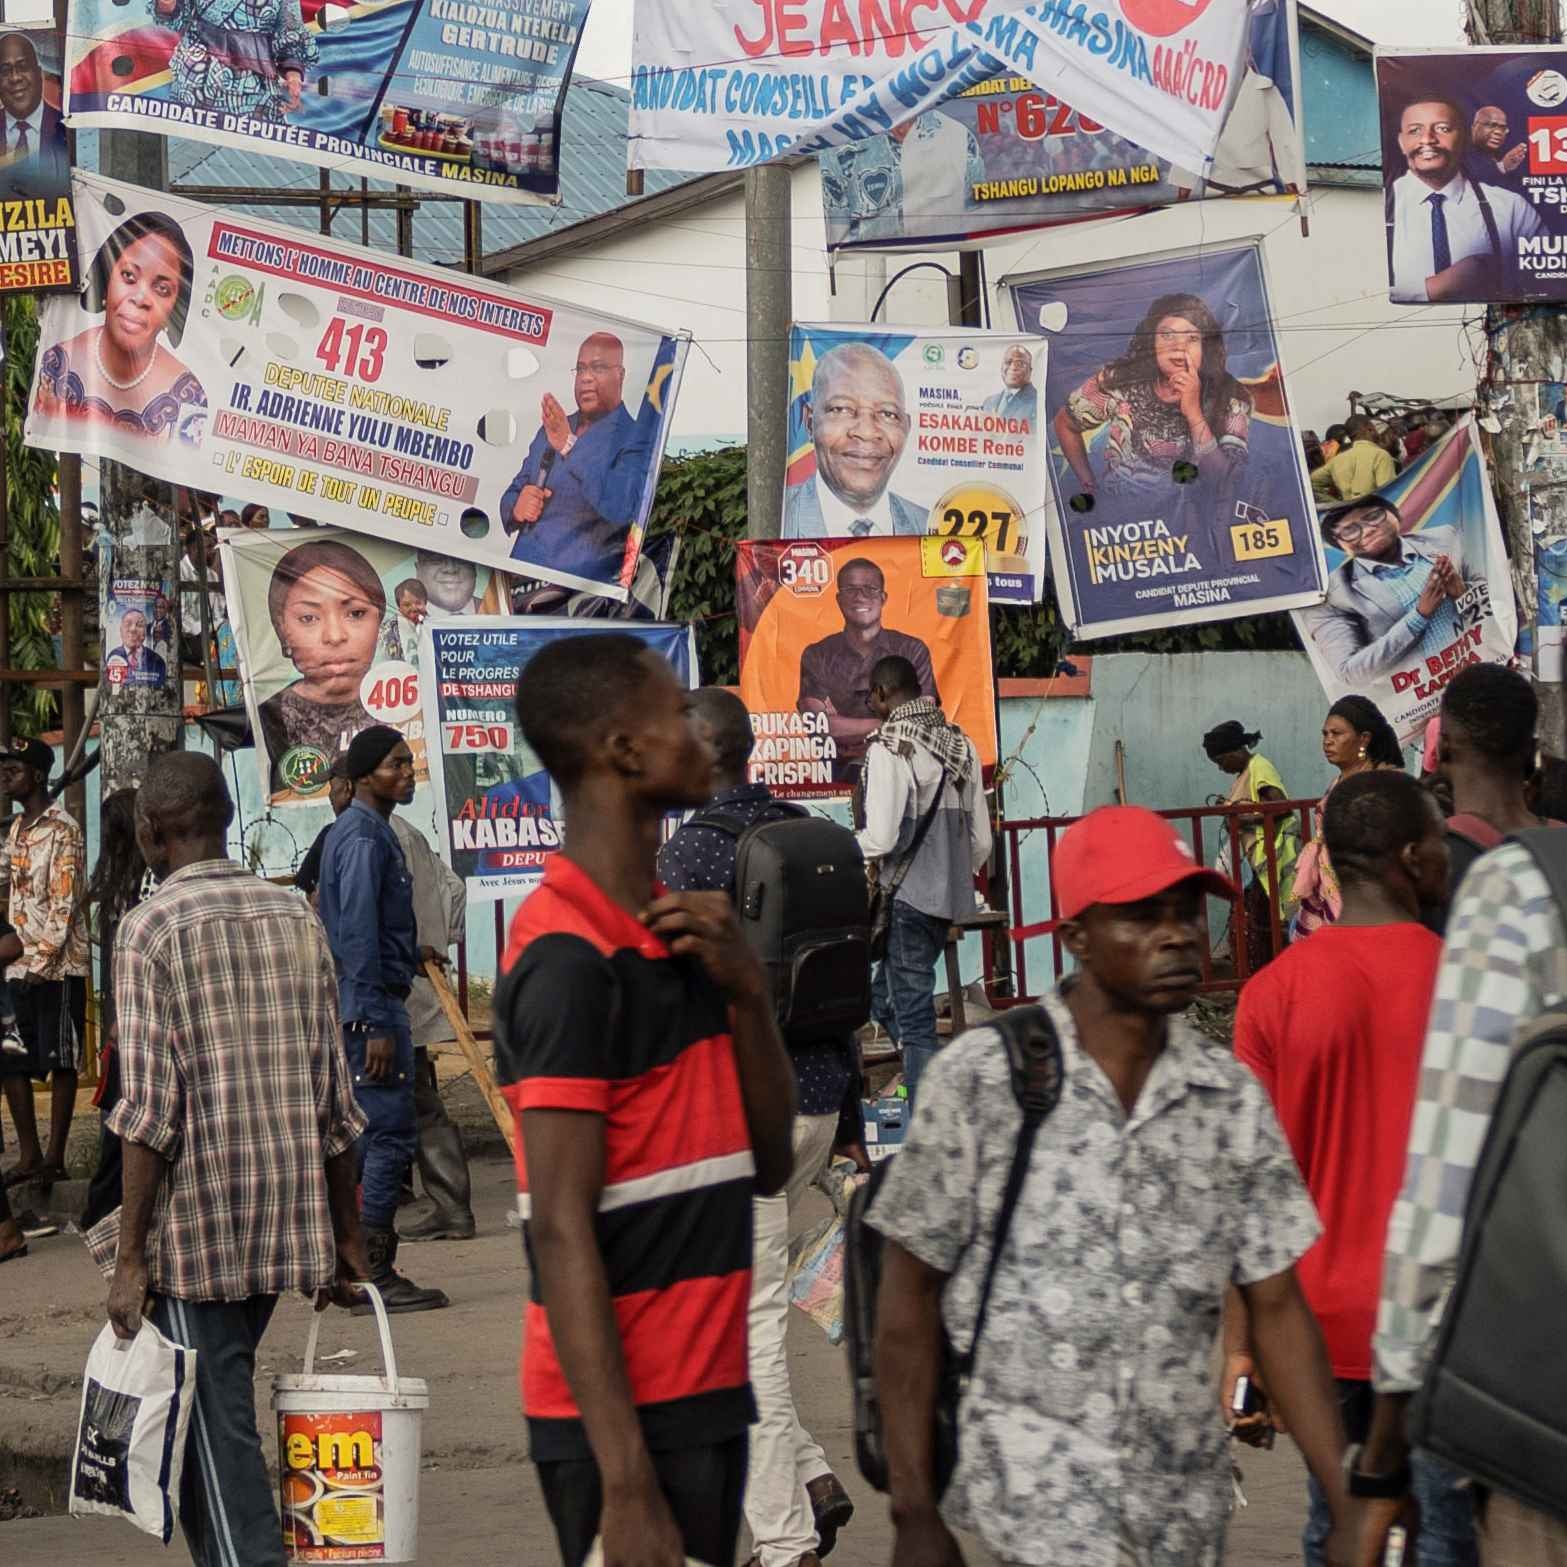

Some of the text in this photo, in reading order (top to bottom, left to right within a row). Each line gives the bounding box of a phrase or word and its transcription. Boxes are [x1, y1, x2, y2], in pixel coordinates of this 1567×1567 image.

[105, 95, 519, 189] CANDIDATE DÉPUTÉE PROVINCIALE MASINA
[971, 165, 1159, 201] TSHANGU LOPANGO NA NGA
[315, 317, 388, 383] 413
[256, 389, 474, 471] ADRIENNE YULU MBEMBO
[918, 413, 1031, 435] ESAKALONGA
[917, 434, 1025, 458] KOMBE René
[1090, 522, 1170, 547] NYOTA
[1238, 528, 1280, 553] 185
[1092, 536, 1190, 566] KINZENY
[782, 559, 829, 585] 340
[1095, 553, 1202, 584] MUSALA
[366, 673, 419, 711] 406
[446, 726, 508, 750] 750
[336, 1469, 362, 1481] Paint
